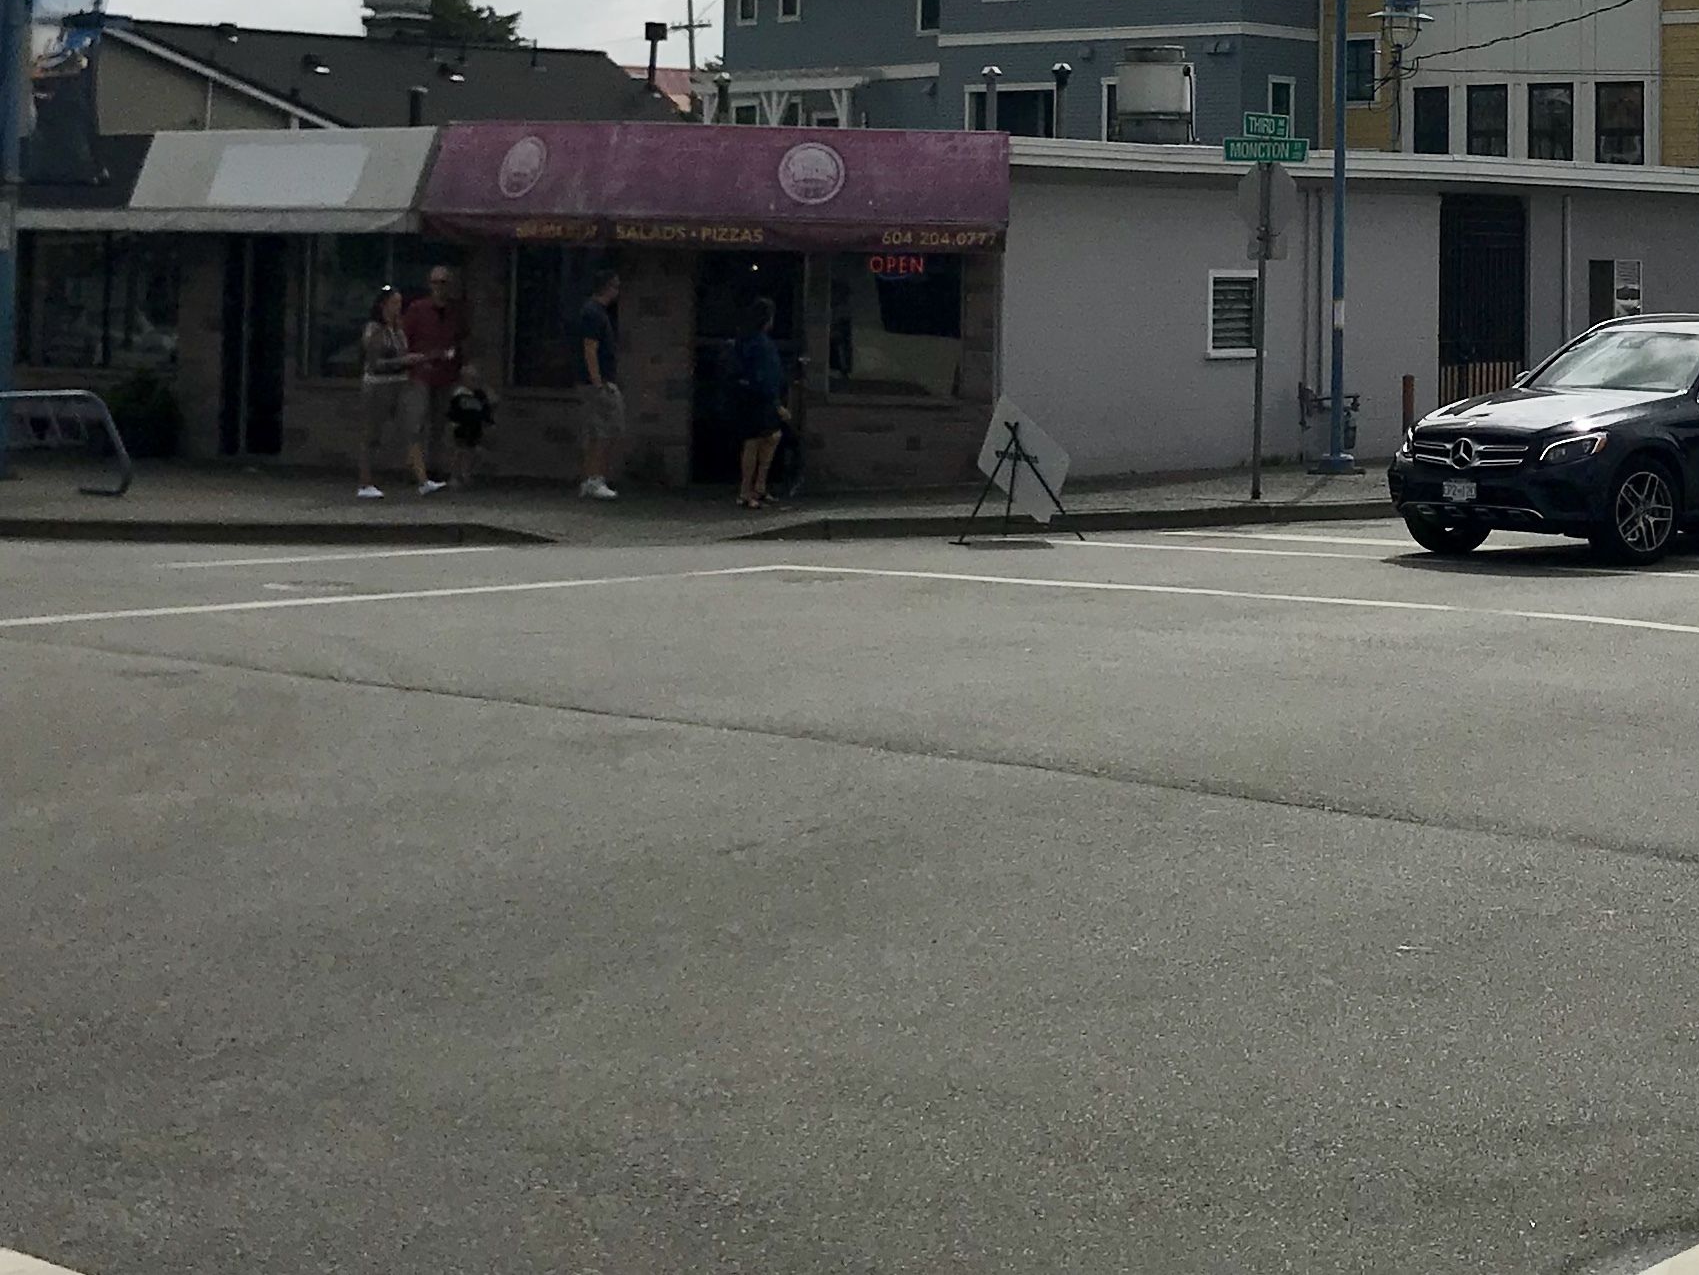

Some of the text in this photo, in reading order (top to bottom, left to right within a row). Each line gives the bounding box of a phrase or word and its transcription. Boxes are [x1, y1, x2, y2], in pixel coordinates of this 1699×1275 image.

[1248, 116, 1275, 134] THIRD
[1230, 142, 1290, 158] MONCTON
[616, 225, 686, 239] SALADS
[702, 227, 764, 242] PIZZAS
[882, 231, 913, 245] 604
[870, 256, 924, 273] OPEN
